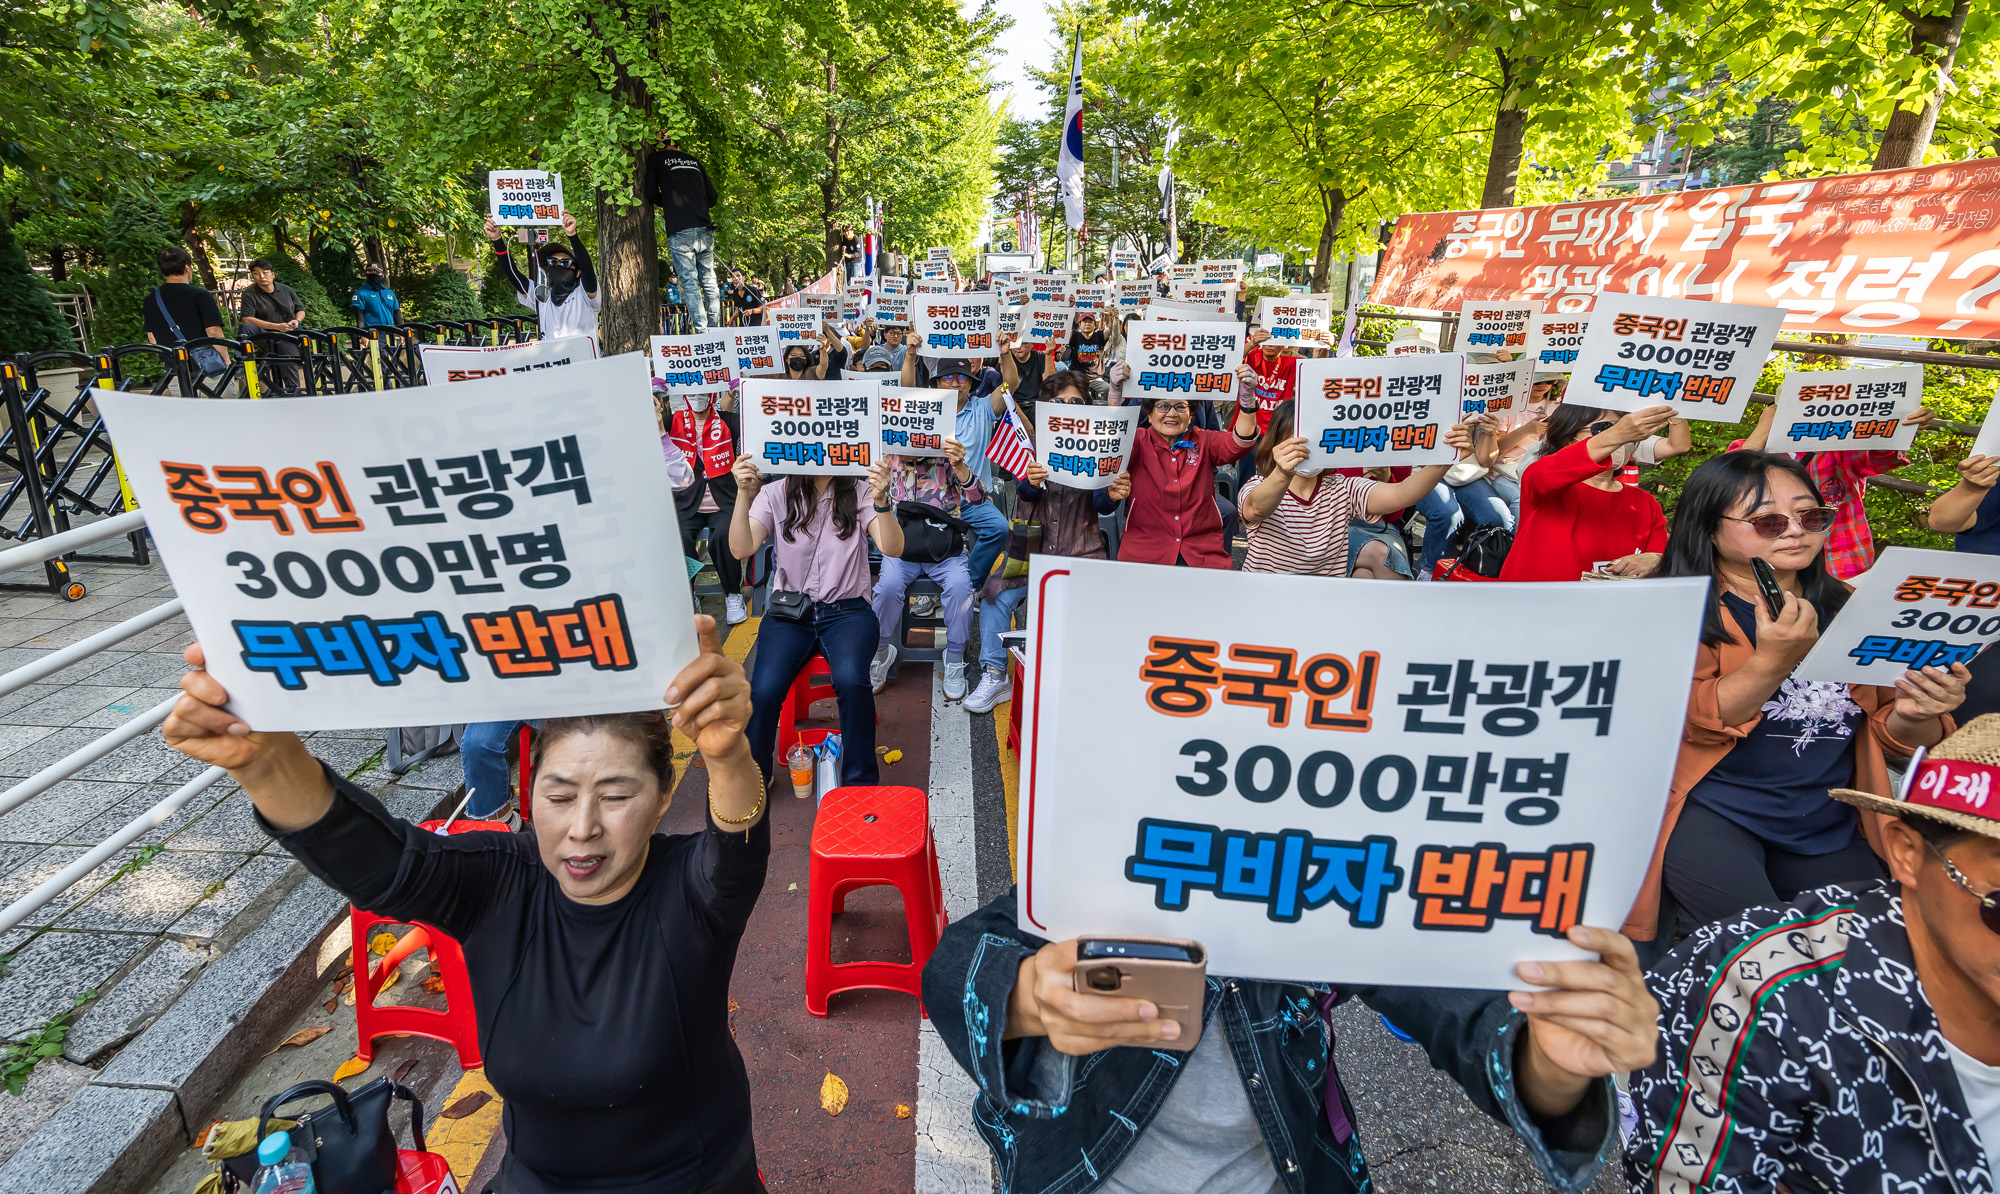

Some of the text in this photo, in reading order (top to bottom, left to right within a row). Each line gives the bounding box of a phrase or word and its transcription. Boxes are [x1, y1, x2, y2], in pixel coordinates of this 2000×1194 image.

[497, 178, 555, 190] 중국인 관광객
[502, 192, 551, 202] 3000만명
[499, 205, 559, 219] 무비자 반대
[1444, 180, 1819, 259] 중국인 무비자 입국
[927, 305, 990, 318] 중국인 관광객
[1000, 313, 1020, 321] 관광객
[1273, 307, 1297, 316] 중국인
[1472, 310, 1531, 320] 중국인 관광객
[933, 319, 985, 330] 3000만명
[1276, 318, 1317, 326] 3000만명
[1476, 321, 1524, 331] 3000만명
[1542, 322, 1578, 335] 중국인
[1613, 313, 1688, 342] 중국인
[1691, 322, 1757, 347] 관광객
[744, 335, 769, 344] 관광객
[801, 331, 816, 339] 반대
[928, 333, 991, 349] 무비자 반대
[1271, 327, 1320, 340] 무비자 반대
[1468, 333, 1526, 346] 무비자 반대
[661, 341, 726, 357] 중국인 관광객
[737, 346, 766, 355] 00만명
[1141, 334, 1236, 351] 중국인 관광객
[1394, 345, 1417, 355] 중국인
[668, 355, 722, 369] 3000만명
[752, 356, 773, 368] 반대
[1148, 354, 1225, 369] 3000만명
[1617, 342, 1736, 371] 3000만명
[666, 367, 730, 386] 무비자 반대
[1139, 372, 1232, 393] 무비자 반대
[1483, 371, 1516, 385] 관광객
[1595, 364, 1736, 404] 무비자 반대
[1323, 376, 1382, 400] 중국인
[1387, 374, 1442, 397] 관광객
[1798, 382, 1907, 401] 중국인 관광객
[761, 396, 868, 416] 중국인 관광객
[882, 397, 942, 415] 국인 관광객
[1333, 399, 1430, 421] 3000만명
[1488, 395, 1513, 412] 반대
[1803, 402, 1895, 417] 3000만명
[771, 419, 859, 438] 3000만명
[882, 414, 934, 430] 000만명
[1048, 416, 1128, 435] 중국인 관광객
[1788, 419, 1899, 441] 무비자 반대
[882, 430, 941, 449] 비자 반대
[1055, 436, 1121, 453] 3000만명
[1320, 424, 1438, 453] 무비자 반대
[710, 450, 731, 462] YOON
[764, 442, 870, 466] 무비자 반대
[1048, 452, 1123, 477] 무비자 반대
[160, 435, 591, 536] 중국인 관광객
[226, 524, 571, 599] 3000만명
[1891, 609, 2000, 636] 3000
[231, 592, 637, 691] 무비자 반대
[1139, 635, 1620, 736] 중국인 관광객
[1175, 739, 1569, 825] 3000만명
[1919, 763, 1992, 808] 이재
[1125, 817, 1595, 937] 무비자 반대
